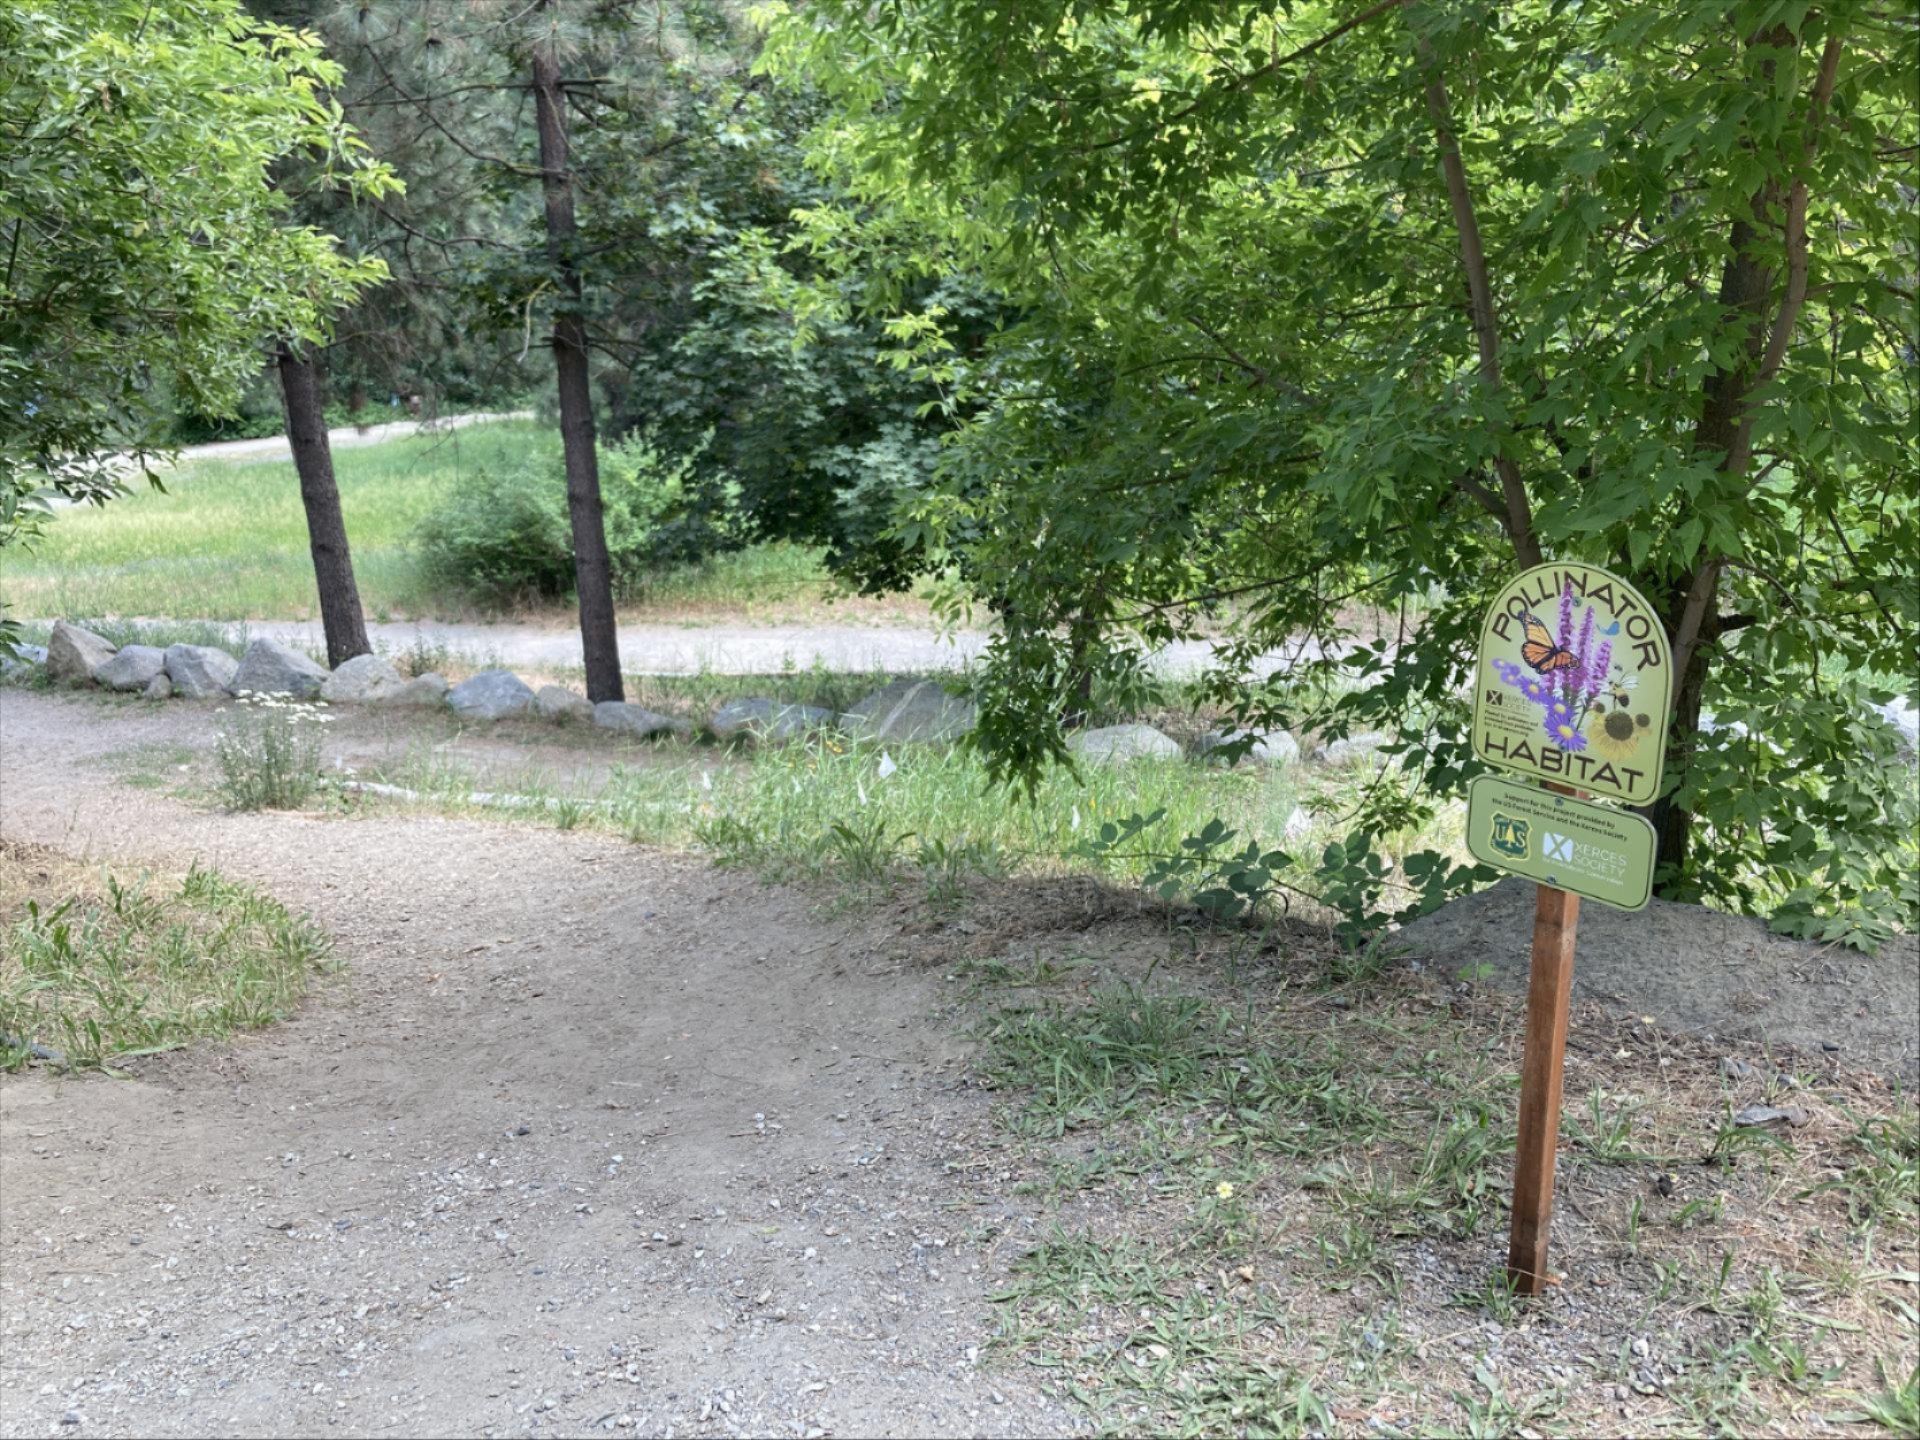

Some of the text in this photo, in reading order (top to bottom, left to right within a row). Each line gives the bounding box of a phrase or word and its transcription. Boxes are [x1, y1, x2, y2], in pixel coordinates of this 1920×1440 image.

[1491, 570, 1661, 671] POLLINATOR
[1484, 731, 1644, 793] HABITAT
[1492, 797, 1503, 806] the
[1512, 803, 1532, 814] Forest
[1532, 808, 1555, 820] Service
[1556, 816, 1569, 825] and
[1569, 819, 1579, 828] the
[1603, 828, 1628, 842] Society
[1504, 792, 1616, 830] Support for this project provided by
[1574, 853, 1626, 877] SOCIETY
[1575, 841, 1627, 866] XERCES
